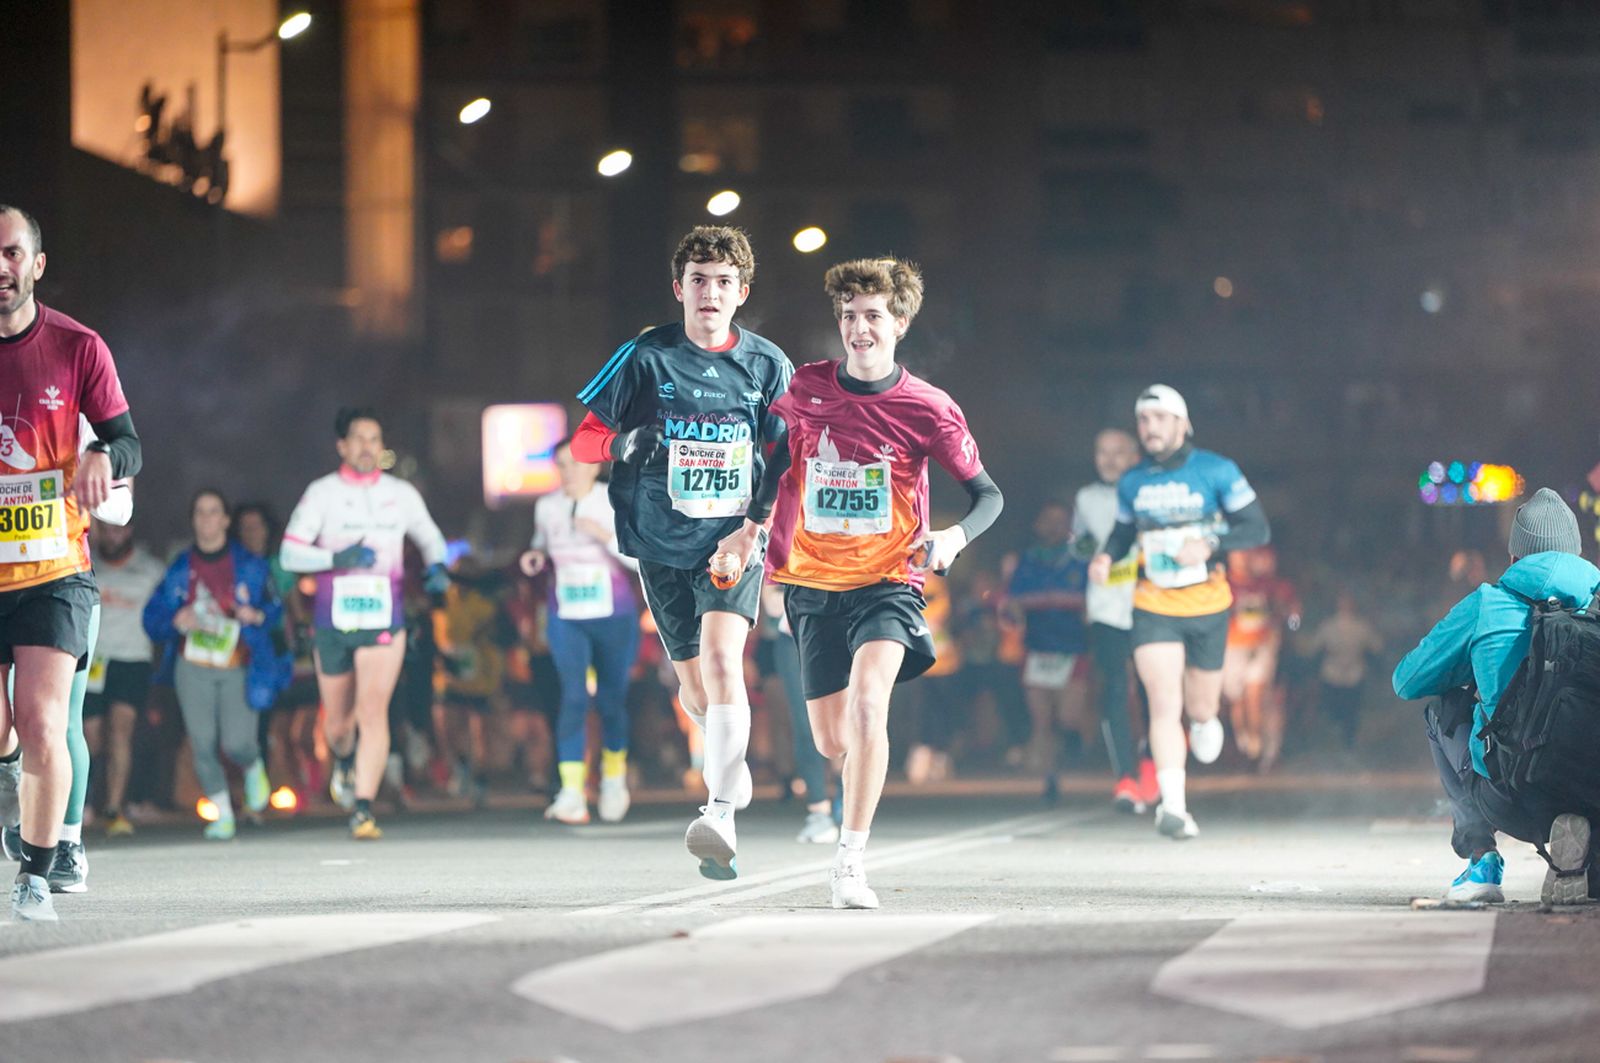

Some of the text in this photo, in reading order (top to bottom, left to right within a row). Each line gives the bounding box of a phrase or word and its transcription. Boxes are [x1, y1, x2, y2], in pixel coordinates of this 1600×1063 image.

[665, 418, 751, 442] MADRID
[679, 458, 696, 467] SAN
[689, 449, 714, 458] NOCHE
[715, 450, 725, 459] DE
[0, 484, 21, 495] OCHE
[22, 483, 33, 493] DE
[681, 468, 740, 492] 12755
[817, 487, 879, 511] 12755
[0, 504, 53, 533] 3067
